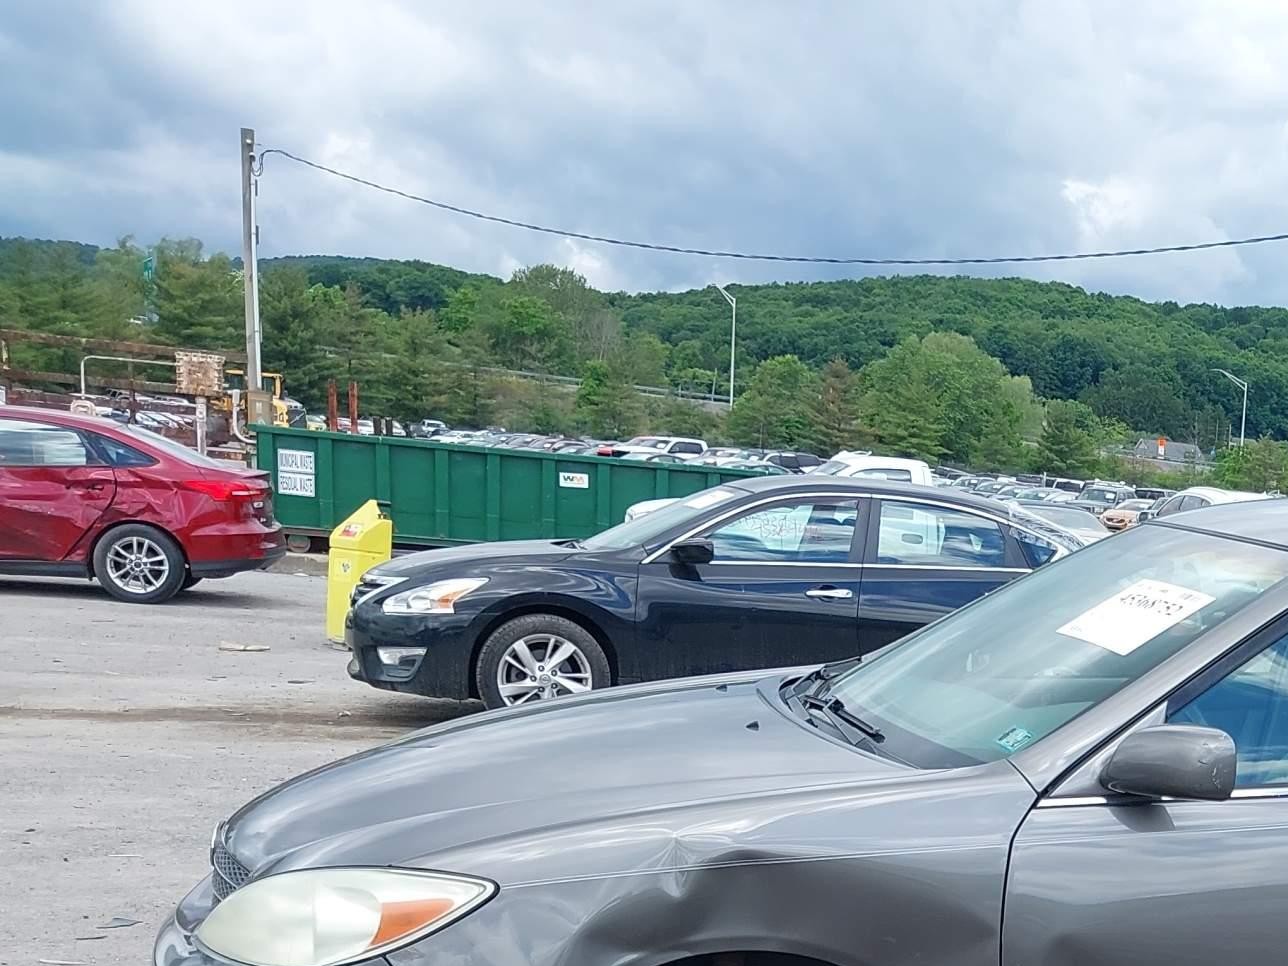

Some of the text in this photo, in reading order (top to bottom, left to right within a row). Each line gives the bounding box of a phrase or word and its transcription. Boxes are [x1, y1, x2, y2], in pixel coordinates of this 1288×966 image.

[300, 454, 313, 470] WASTE
[280, 475, 313, 493] RESIDUAL WASTE
